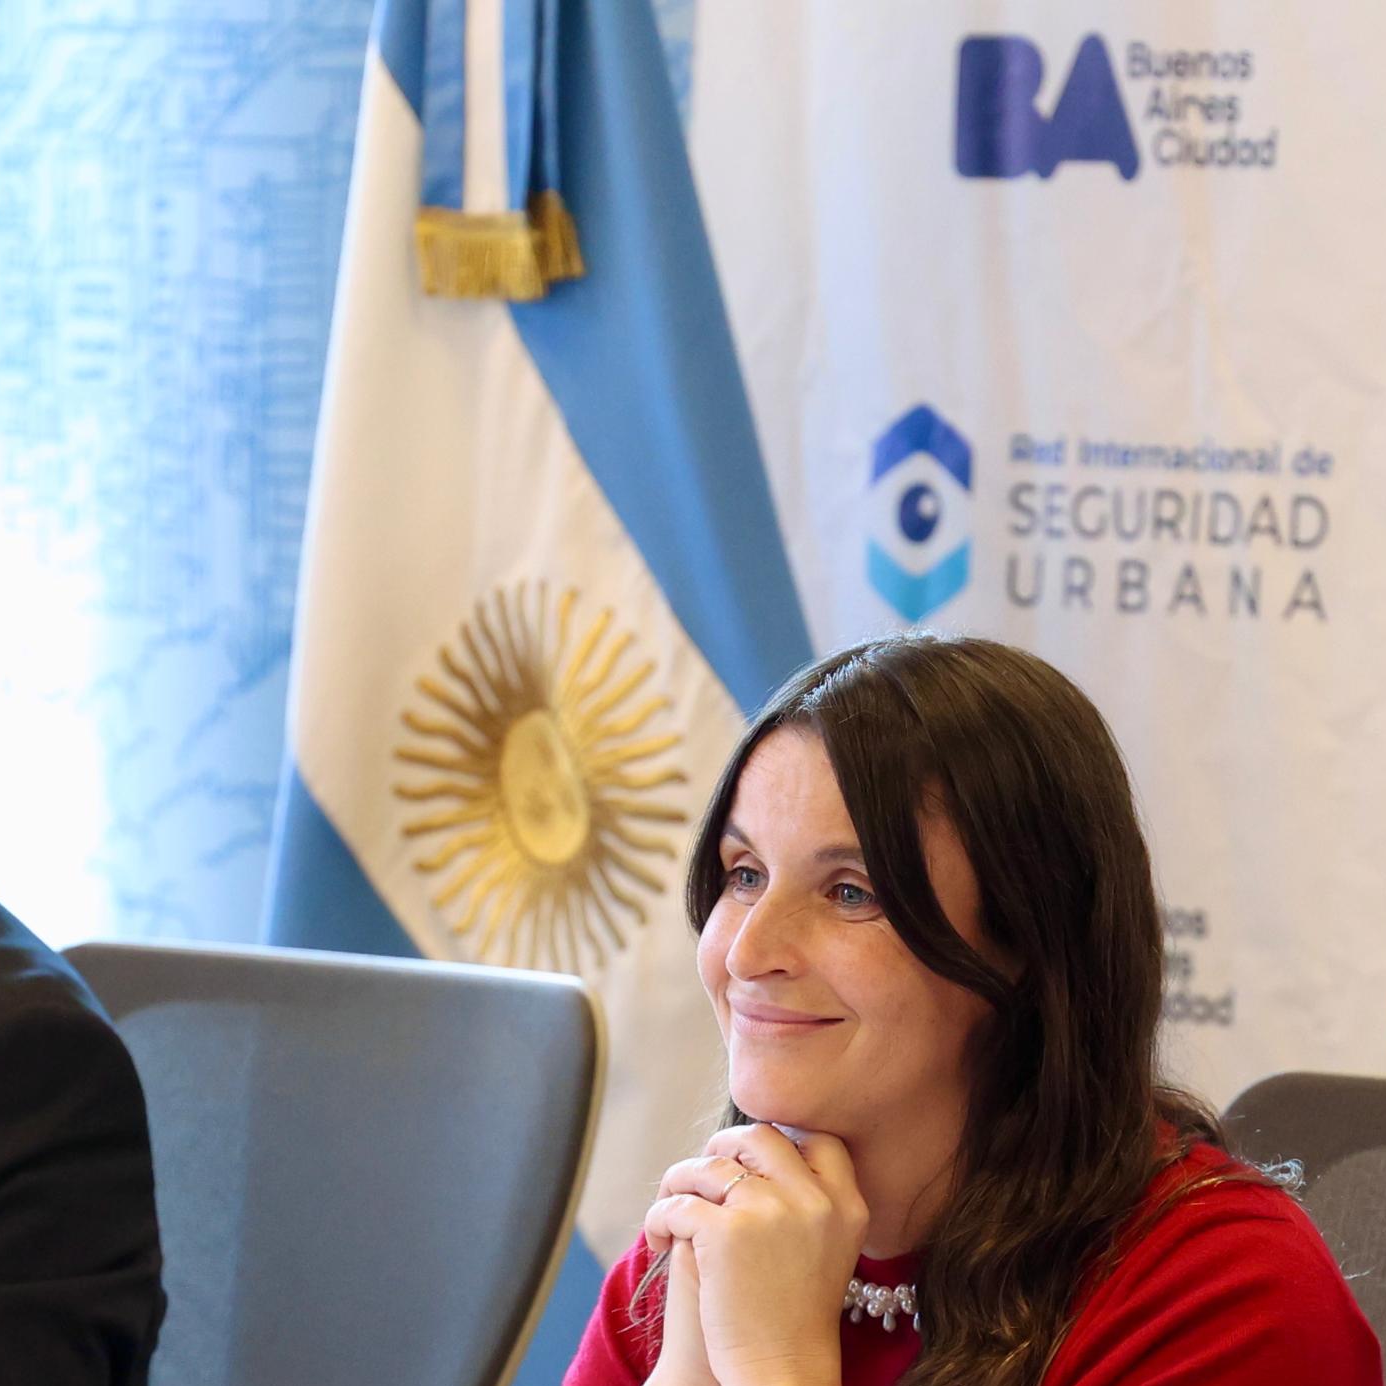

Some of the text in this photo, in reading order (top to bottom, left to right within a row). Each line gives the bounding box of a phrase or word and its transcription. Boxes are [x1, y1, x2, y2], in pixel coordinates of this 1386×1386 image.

[1127, 41, 1252, 79] Buenos
[1144, 87, 1239, 123] Aires
[1152, 127, 1277, 167] Ciudad
[1009, 433, 1335, 476] Red Internacional de
[1008, 482, 1331, 551] SEGURIDAD
[1006, 554, 1329, 623] URBANA
